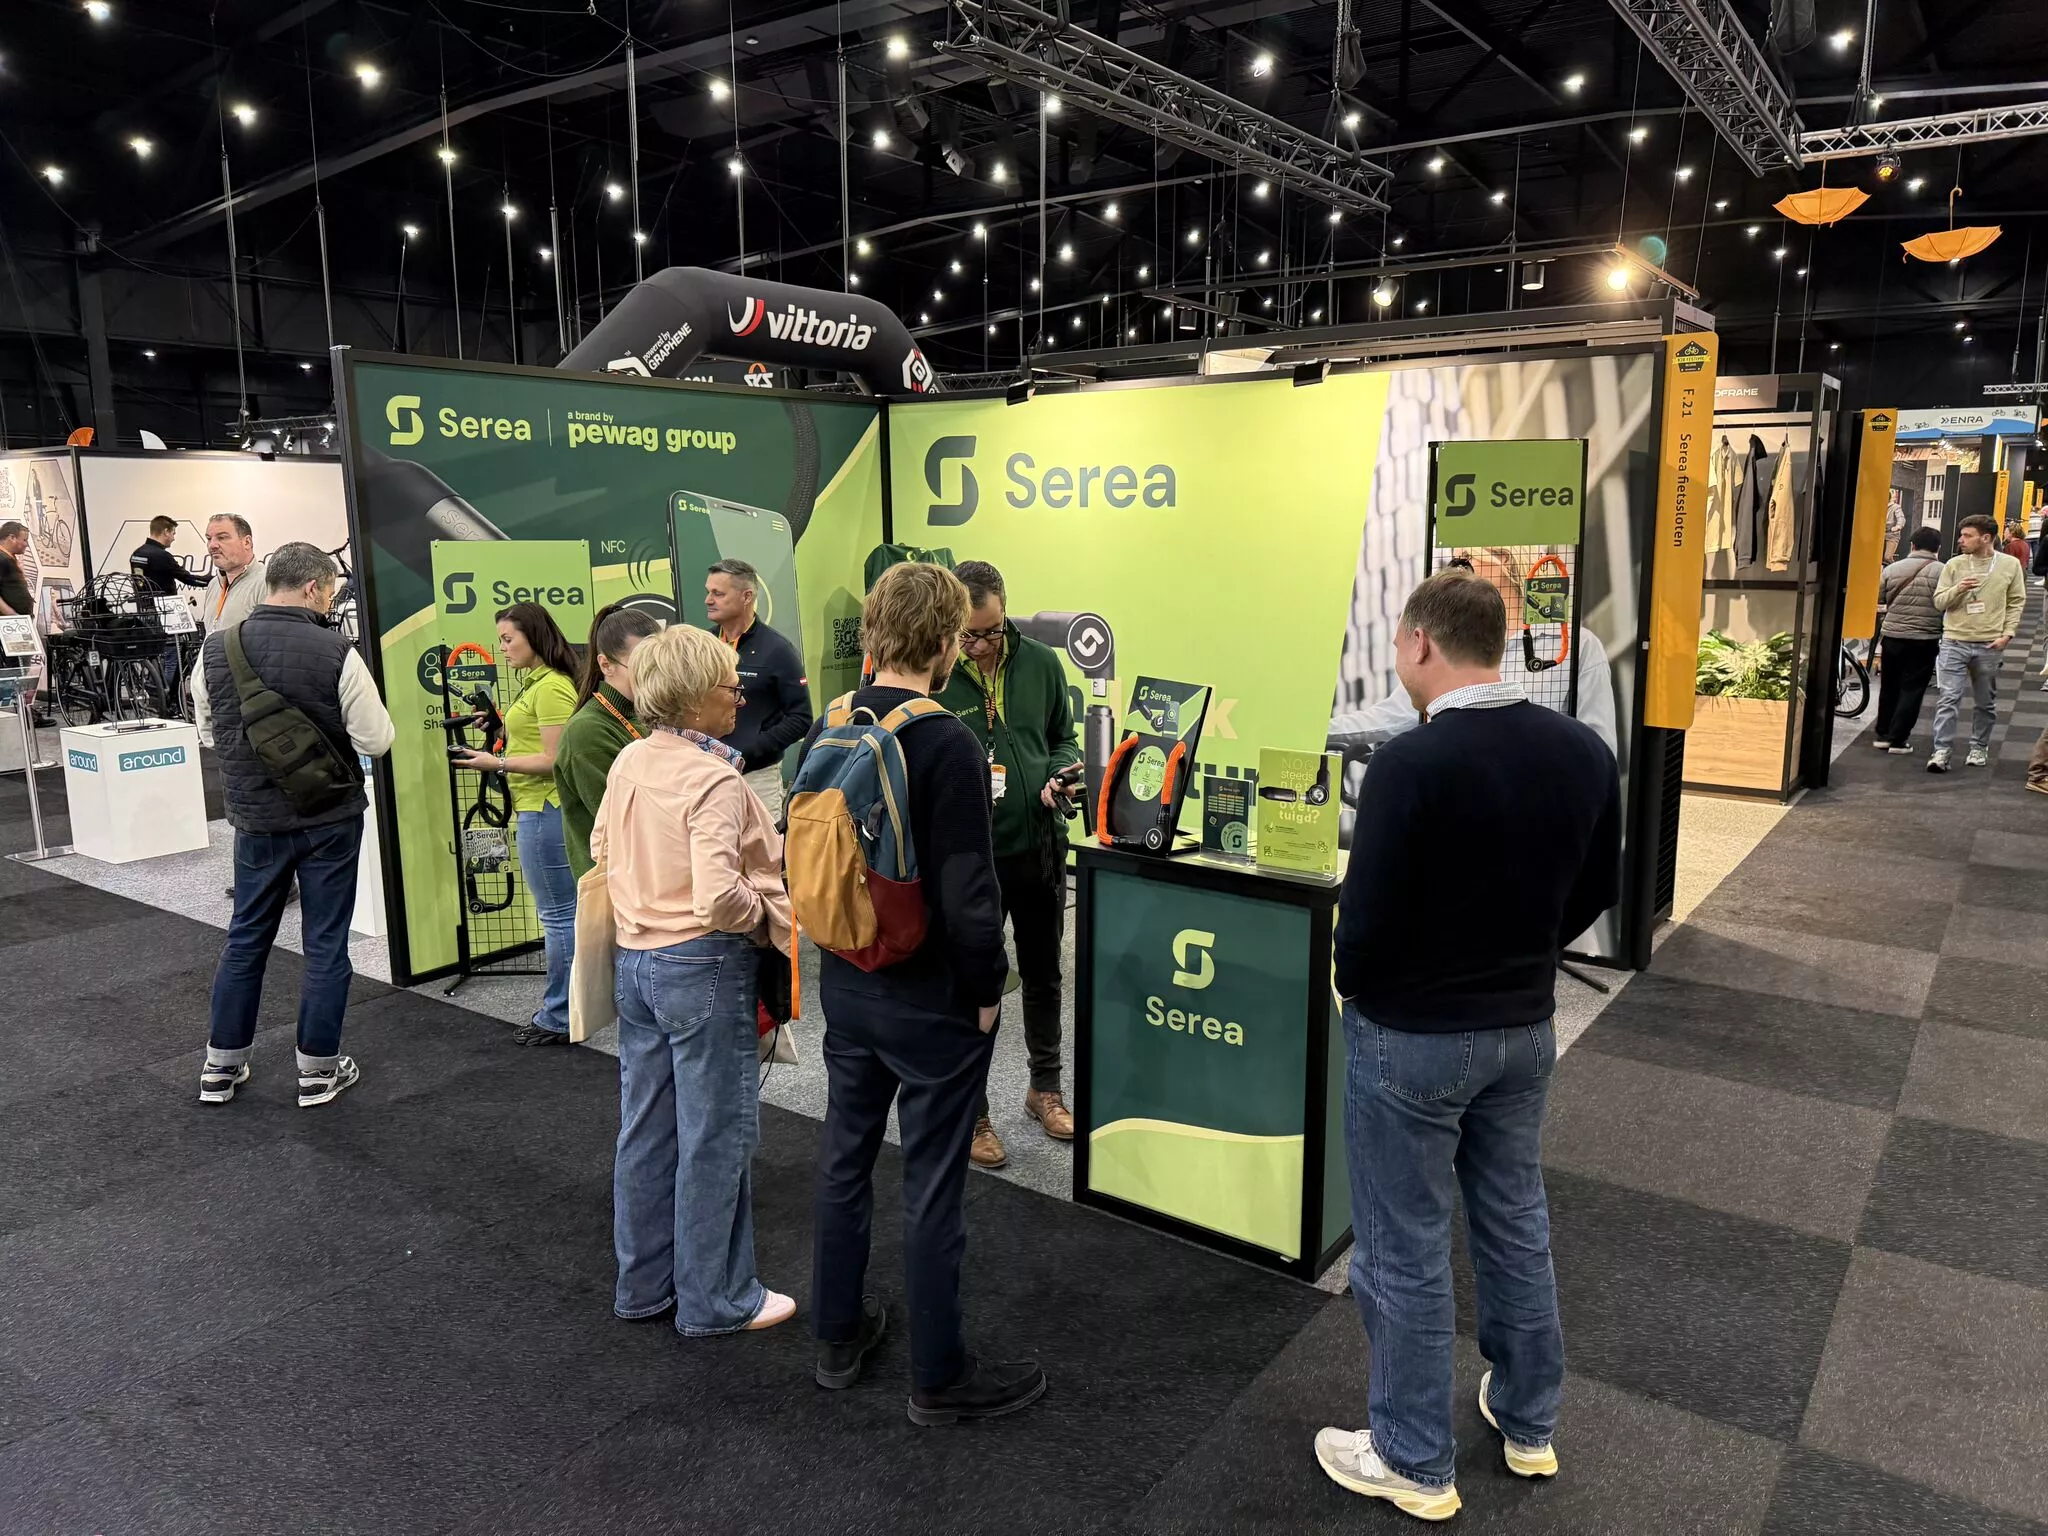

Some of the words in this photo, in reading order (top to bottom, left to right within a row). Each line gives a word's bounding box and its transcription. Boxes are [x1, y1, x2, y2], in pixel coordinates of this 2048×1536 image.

[767, 304, 873, 350] vittoria
[642, 334, 665, 363] powered
[661, 331, 671, 341] by
[648, 322, 692, 370] GRAPHENE
[1681, 388, 1694, 418] F.21
[438, 407, 532, 441] Serea
[568, 411, 574, 420] a
[575, 411, 601, 422] brand
[603, 412, 613, 424] by
[1950, 415, 1983, 424] ENRA
[568, 421, 659, 452] pewag
[666, 428, 736, 454] group
[1678, 433, 1691, 471] Serea
[1005, 452, 1176, 509] Serea
[1490, 481, 1574, 508] Serea
[689, 503, 711, 515] Serea
[1673, 474, 1689, 547] fietssloten
[601, 540, 626, 554] NFC
[492, 580, 584, 606] Serea
[461, 670, 485, 678] Serea
[1150, 689, 1171, 704] Serea
[426, 704, 443, 716] On
[956, 705, 979, 718] Serea
[70, 753, 97, 770] around
[123, 748, 182, 770] around
[1147, 756, 1165, 768] Serea
[1281, 770, 1313, 781] steeds
[1279, 809, 1320, 824] tuigd?
[1145, 996, 1243, 1046] Serea
